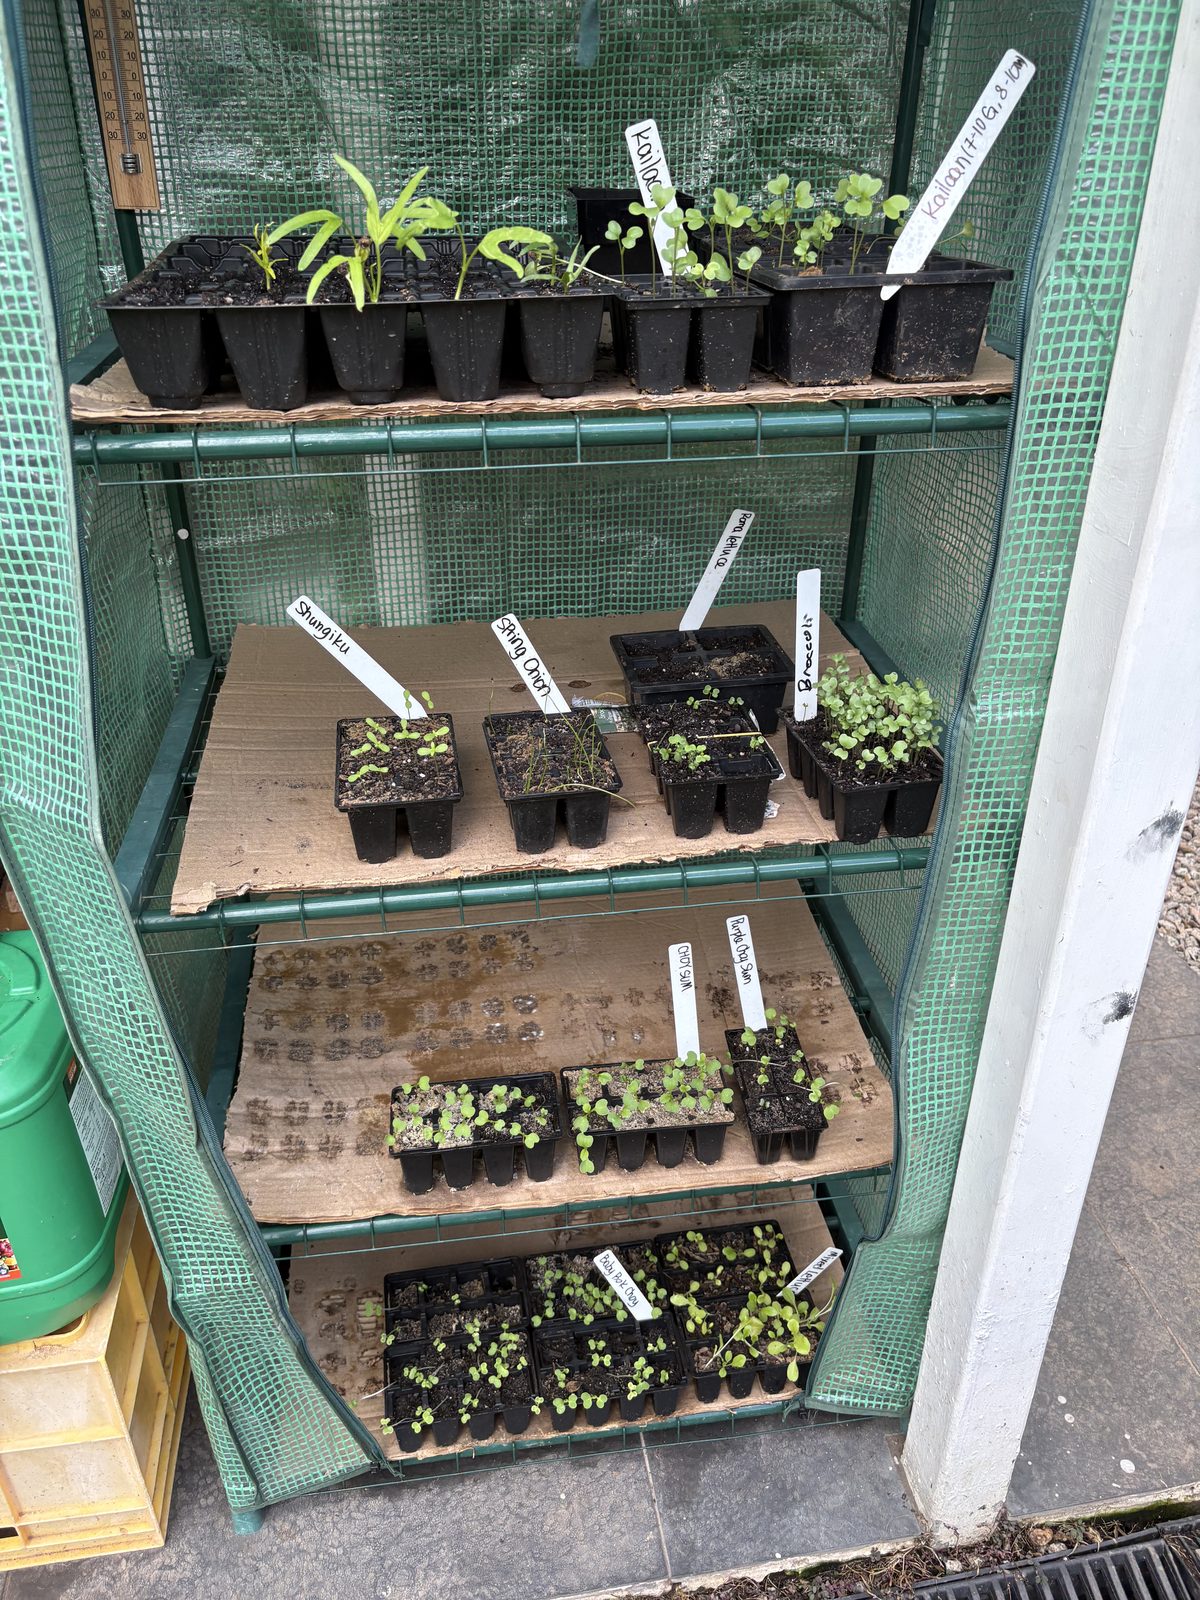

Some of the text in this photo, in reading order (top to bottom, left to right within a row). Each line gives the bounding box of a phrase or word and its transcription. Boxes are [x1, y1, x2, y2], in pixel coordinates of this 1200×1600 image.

[93, 29, 104, 38] 20
[123, 30, 134, 39] 20
[97, 51, 107, 59] 10
[126, 52, 136, 60] 10
[102, 71, 108, 80] 0
[131, 72, 137, 80] 0
[103, 91, 113, 100] 10
[132, 92, 142, 100] 10
[105, 111, 116, 120] 20
[134, 112, 145, 121] 20
[108, 131, 118, 139] 30
[137, 132, 147, 140] 30
[295, 601, 351, 655] Shungiku
[797, 614, 813, 693] Broccoli
[523, 657, 551, 697] Onion
[729, 917, 747, 944] Purple
[677, 945, 693, 993] CHOY SUM
